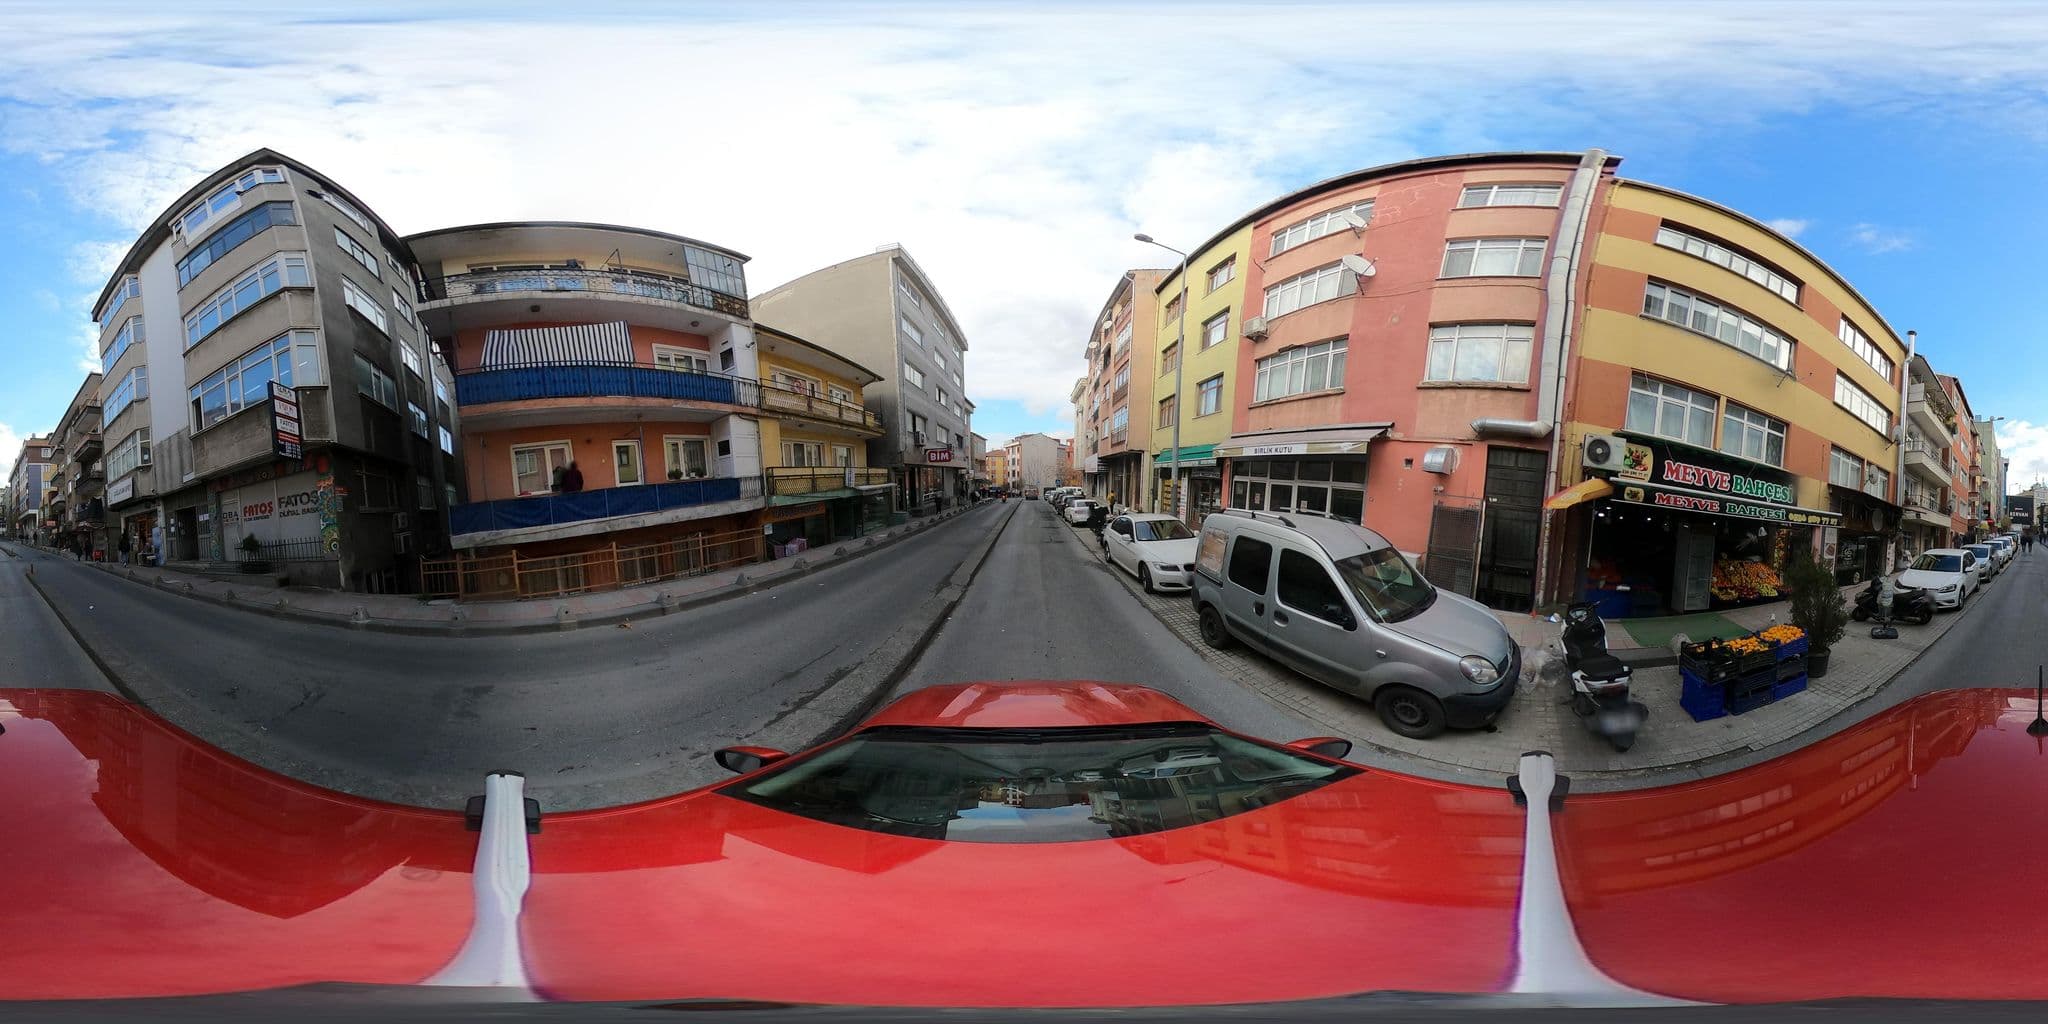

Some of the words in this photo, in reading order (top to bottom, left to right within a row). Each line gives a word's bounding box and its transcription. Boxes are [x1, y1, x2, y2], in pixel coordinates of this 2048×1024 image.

[1663, 460, 1730, 491] MEYVE
[1732, 475, 1793, 503] BAHÇESİ
[1655, 493, 1720, 512] MEYVE
[1726, 503, 1786, 520] BAHÇESİ
